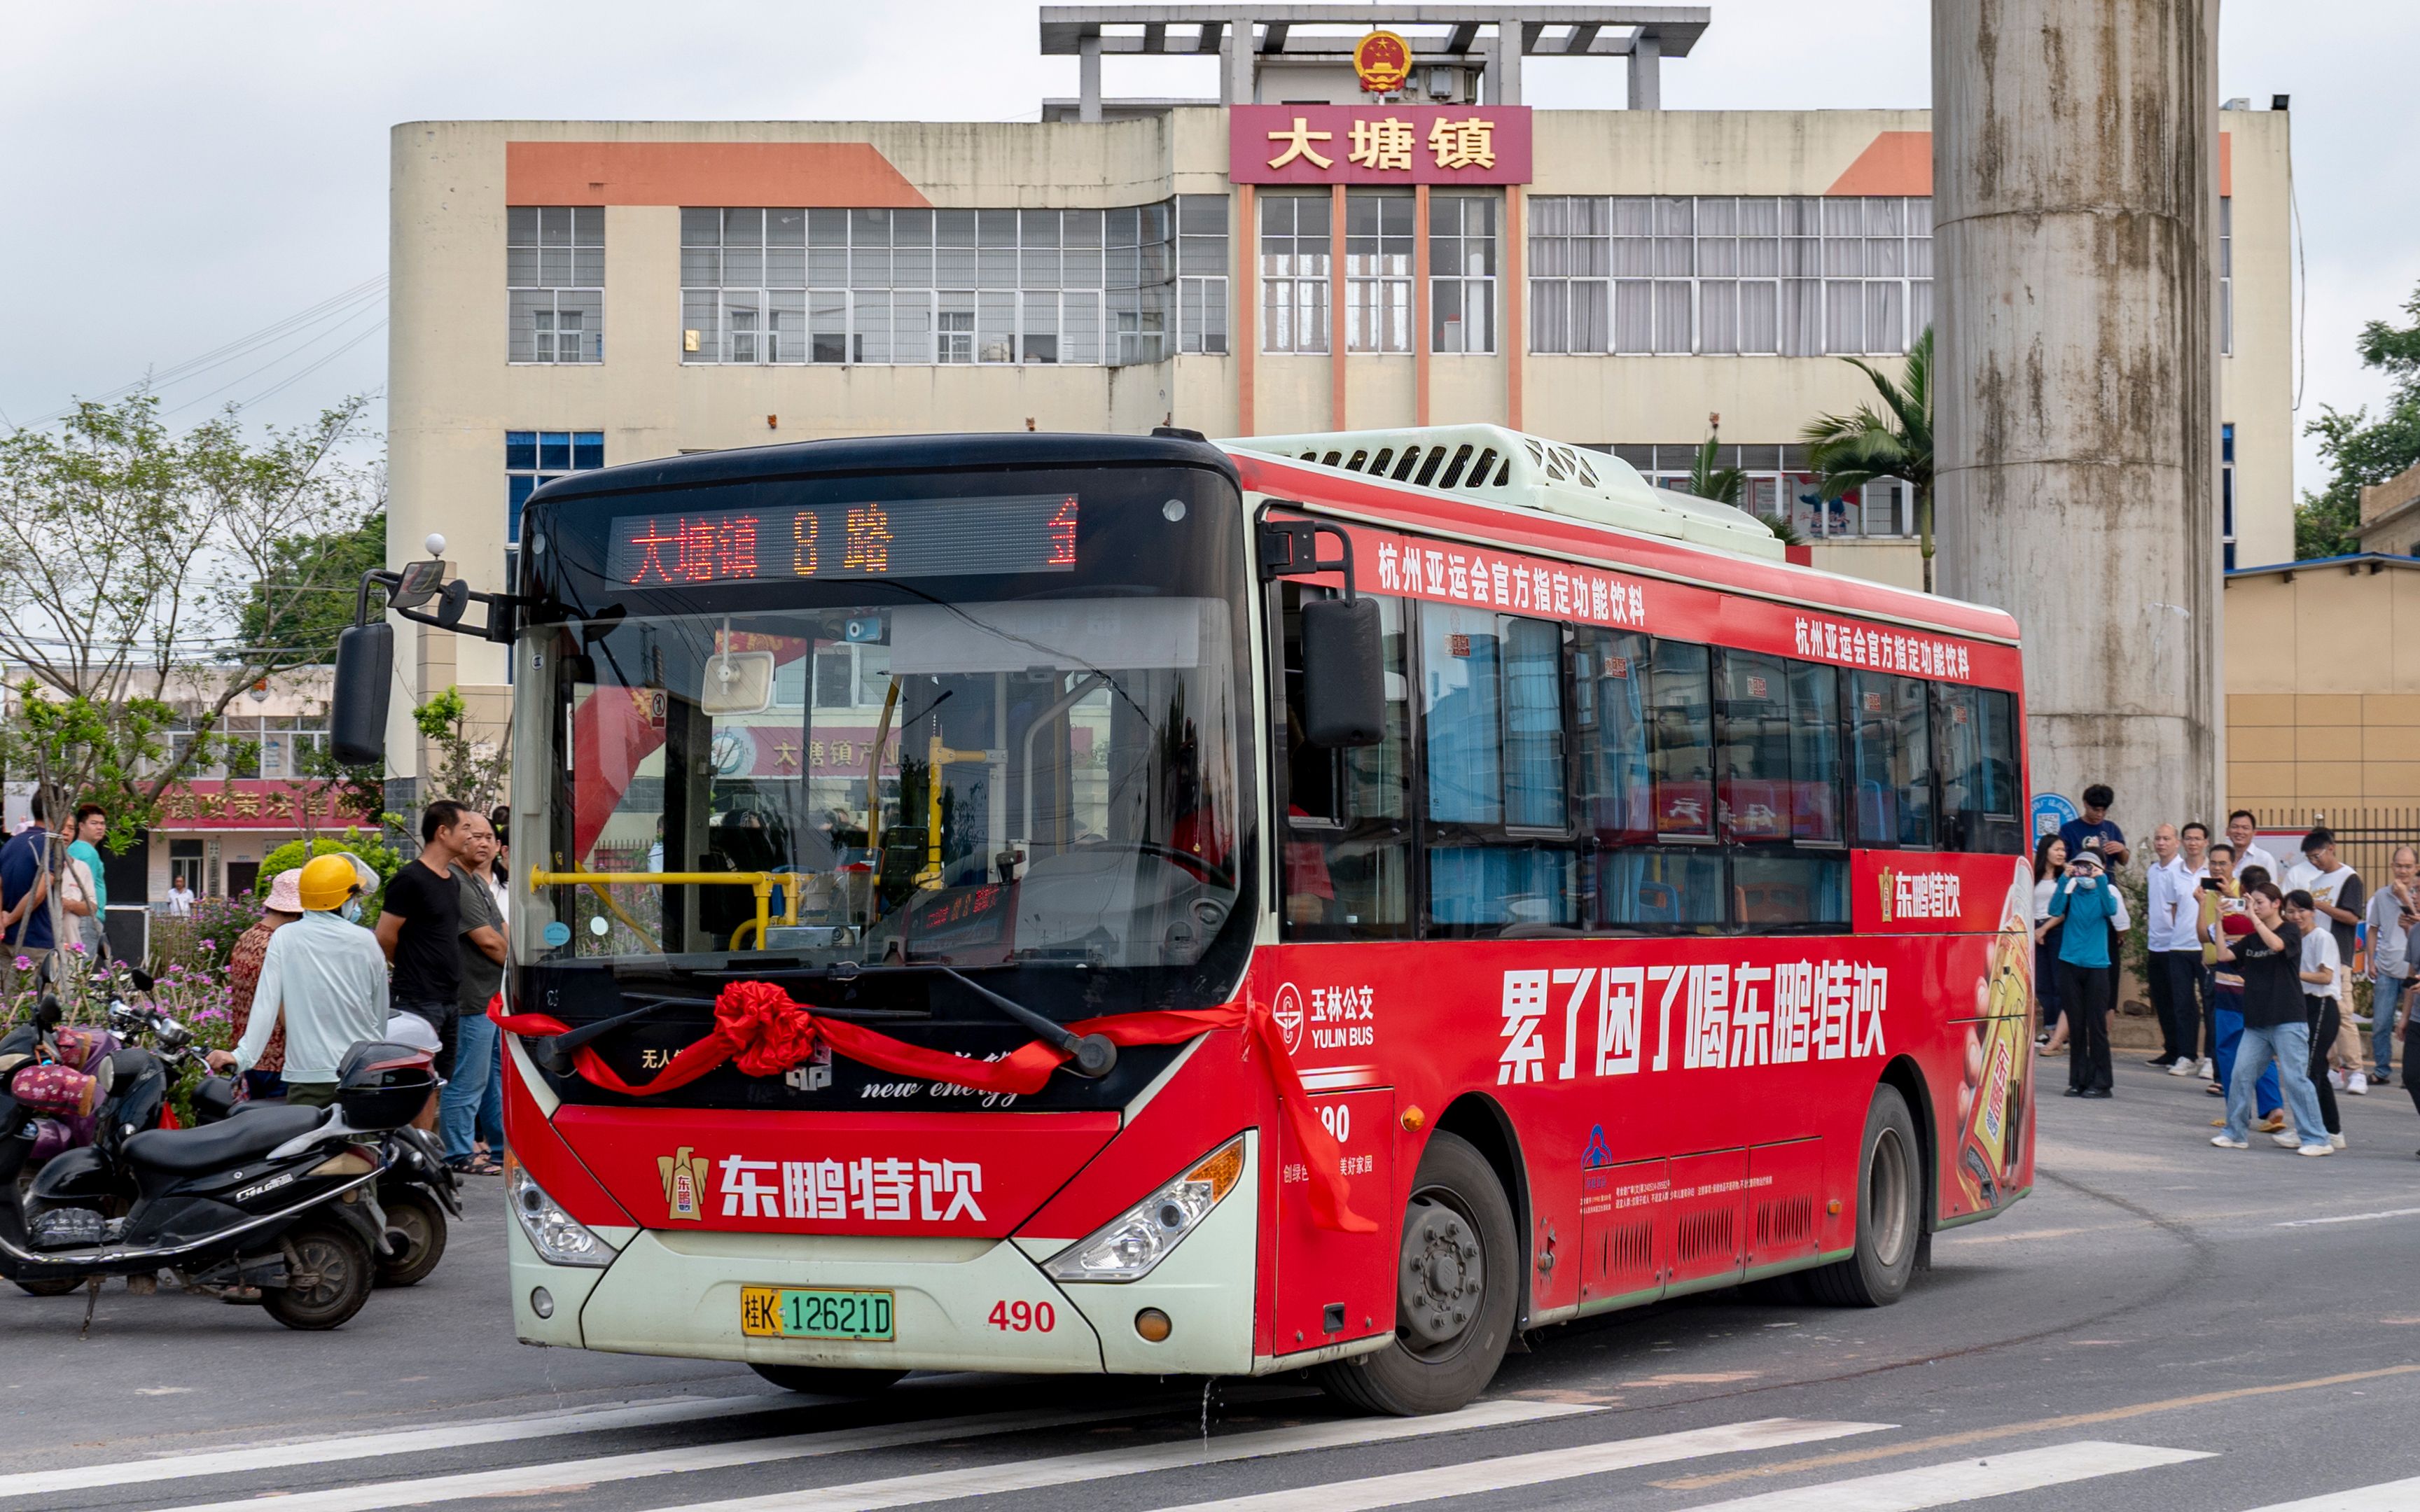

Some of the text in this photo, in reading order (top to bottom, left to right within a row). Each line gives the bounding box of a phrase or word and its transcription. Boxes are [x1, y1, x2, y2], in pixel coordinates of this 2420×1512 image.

[1267, 117, 1496, 170] 大塘镇
[630, 514, 760, 582] 大塘镇
[793, 512, 819, 575] 8
[843, 504, 894, 572] 路
[1377, 542, 1645, 626] 杭州亚运会官方指定功能饮料
[1794, 617, 1970, 680] 杭州亚运会官方指定功能饮料
[1896, 871, 1961, 918] 东鹏特饮
[1311, 985, 1374, 1022] 玉林公交
[1497, 959, 1888, 1085] 累了困了喝东鹏特饮
[1312, 1026, 1374, 1049] YULIN BUS
[642, 1049, 683, 1068] 无人
[861, 1083, 923, 1098] new
[1314, 1105, 1350, 1142] 90
[1340, 1155, 1373, 1176] 美好家园
[718, 1154, 987, 1222] 东鹏特饮
[793, 1296, 891, 1334] 12621D
[988, 1301, 1056, 1333] 490
